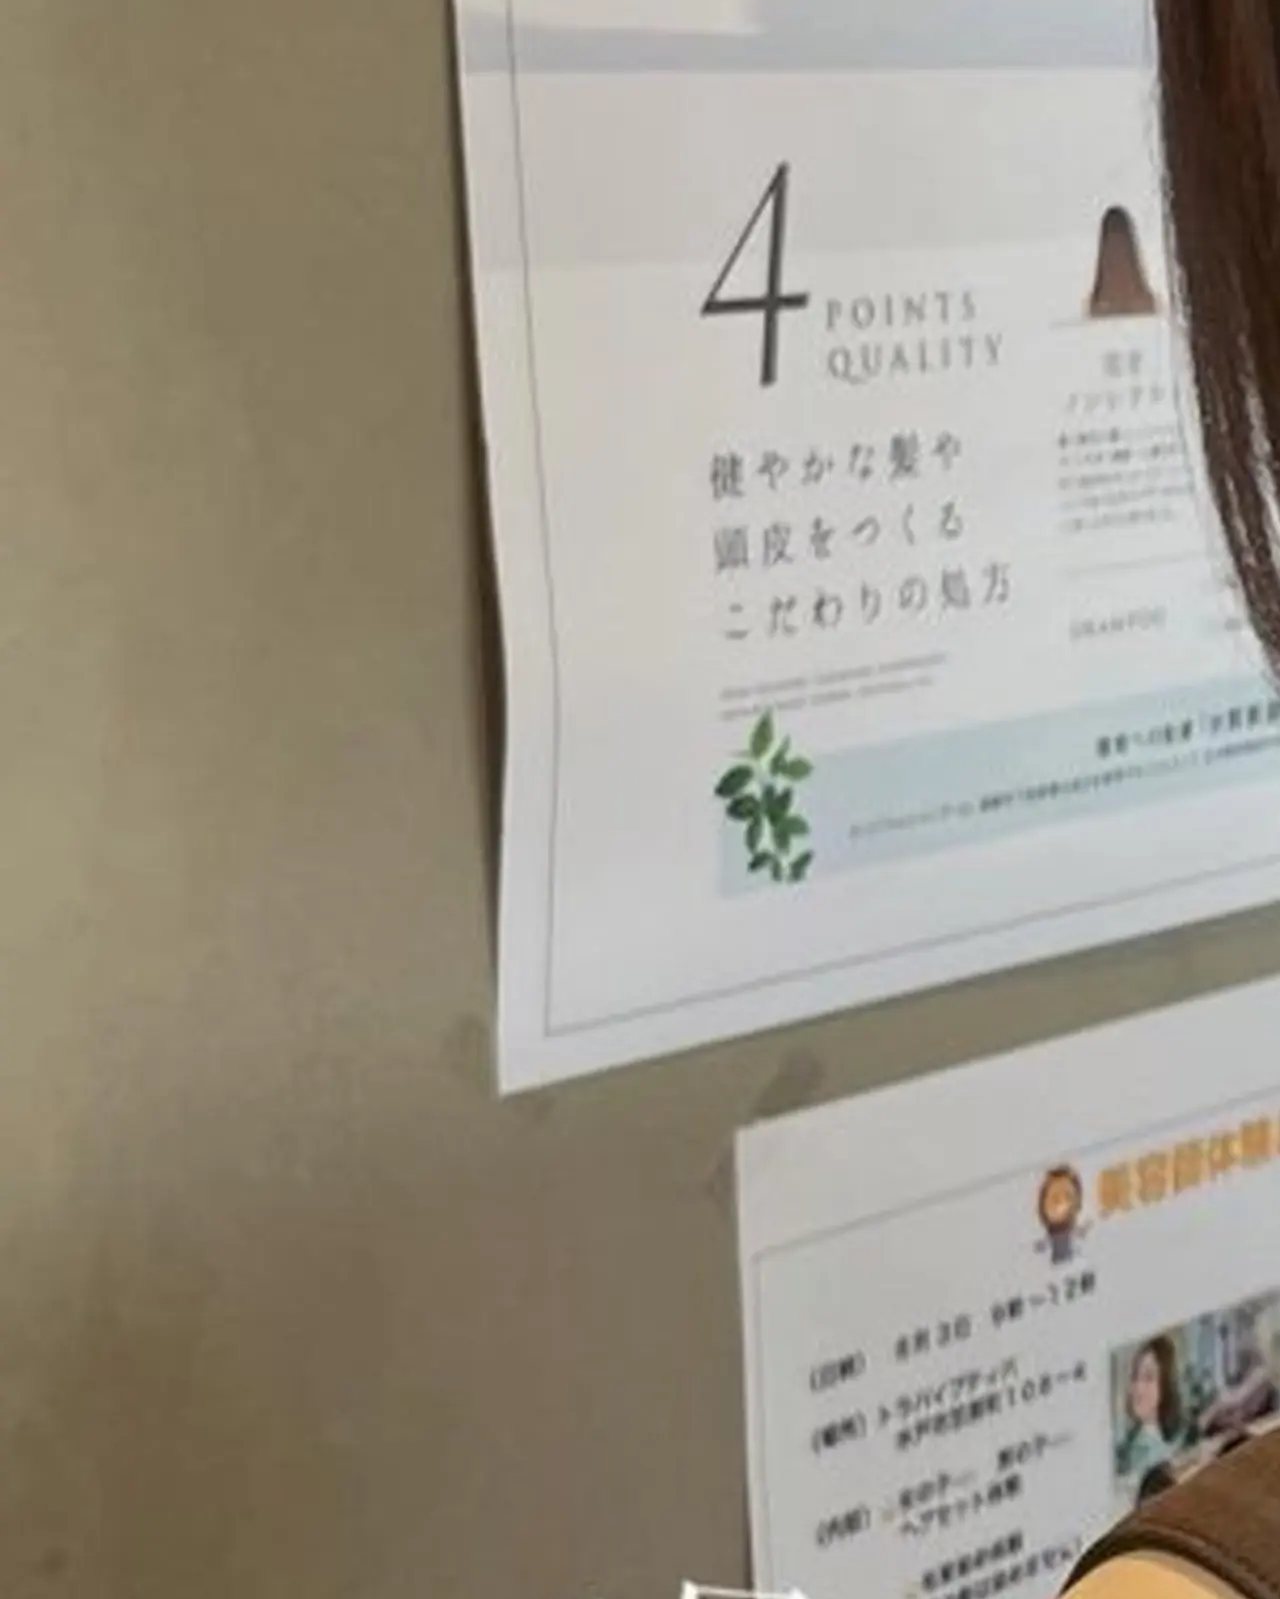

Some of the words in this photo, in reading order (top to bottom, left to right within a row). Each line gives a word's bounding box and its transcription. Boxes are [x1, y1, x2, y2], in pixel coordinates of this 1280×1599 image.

[700, 162, 809, 387] 4
[824, 292, 977, 332] POINTS
[826, 334, 1002, 384] QUALITY
[710, 430, 965, 500] 健やかな髪や
[714, 502, 964, 573] 頭皮をつくる
[724, 564, 1012, 641] こだわりの処方
